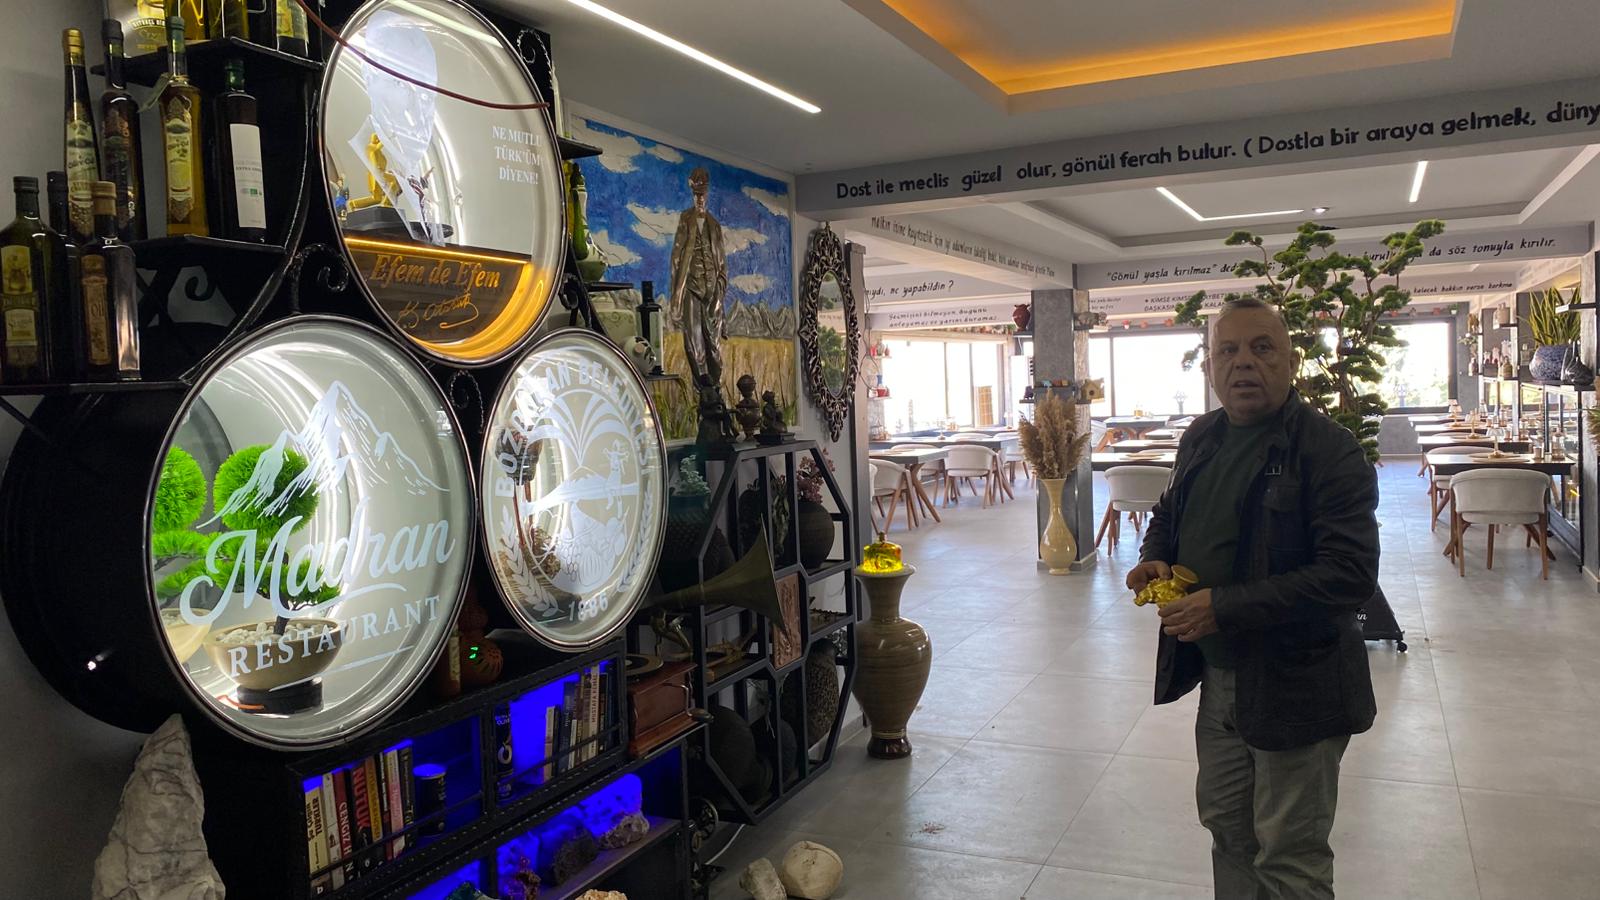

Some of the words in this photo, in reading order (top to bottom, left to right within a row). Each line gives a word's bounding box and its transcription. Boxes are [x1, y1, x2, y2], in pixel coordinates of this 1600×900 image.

[492, 126, 507, 140] NE
[836, 180, 872, 199] Dost
[876, 179, 895, 196] ile
[899, 173, 950, 192] meclis
[961, 165, 1002, 192] güzel
[1016, 161, 1057, 180] olur,
[1062, 152, 1116, 178] gönül
[1119, 146, 1172, 169] ferah
[1177, 141, 1237, 162] bulur.
[1330, 127, 1360, 147] bir
[1366, 122, 1435, 143] araya
[1441, 107, 1537, 136] gelmek,
[370, 254, 423, 288] Efem
[429, 259, 450, 283] de
[454, 261, 500, 291] Efem
[1428, 246, 1442, 257] da
[1447, 244, 1467, 256] söz
[1472, 240, 1514, 258] tonuyla
[1143, 269, 1170, 284] yaşla
[180, 496, 456, 626] Madran
[228, 595, 441, 678] RESTAURANT
[352, 767, 371, 828] NUTUK
